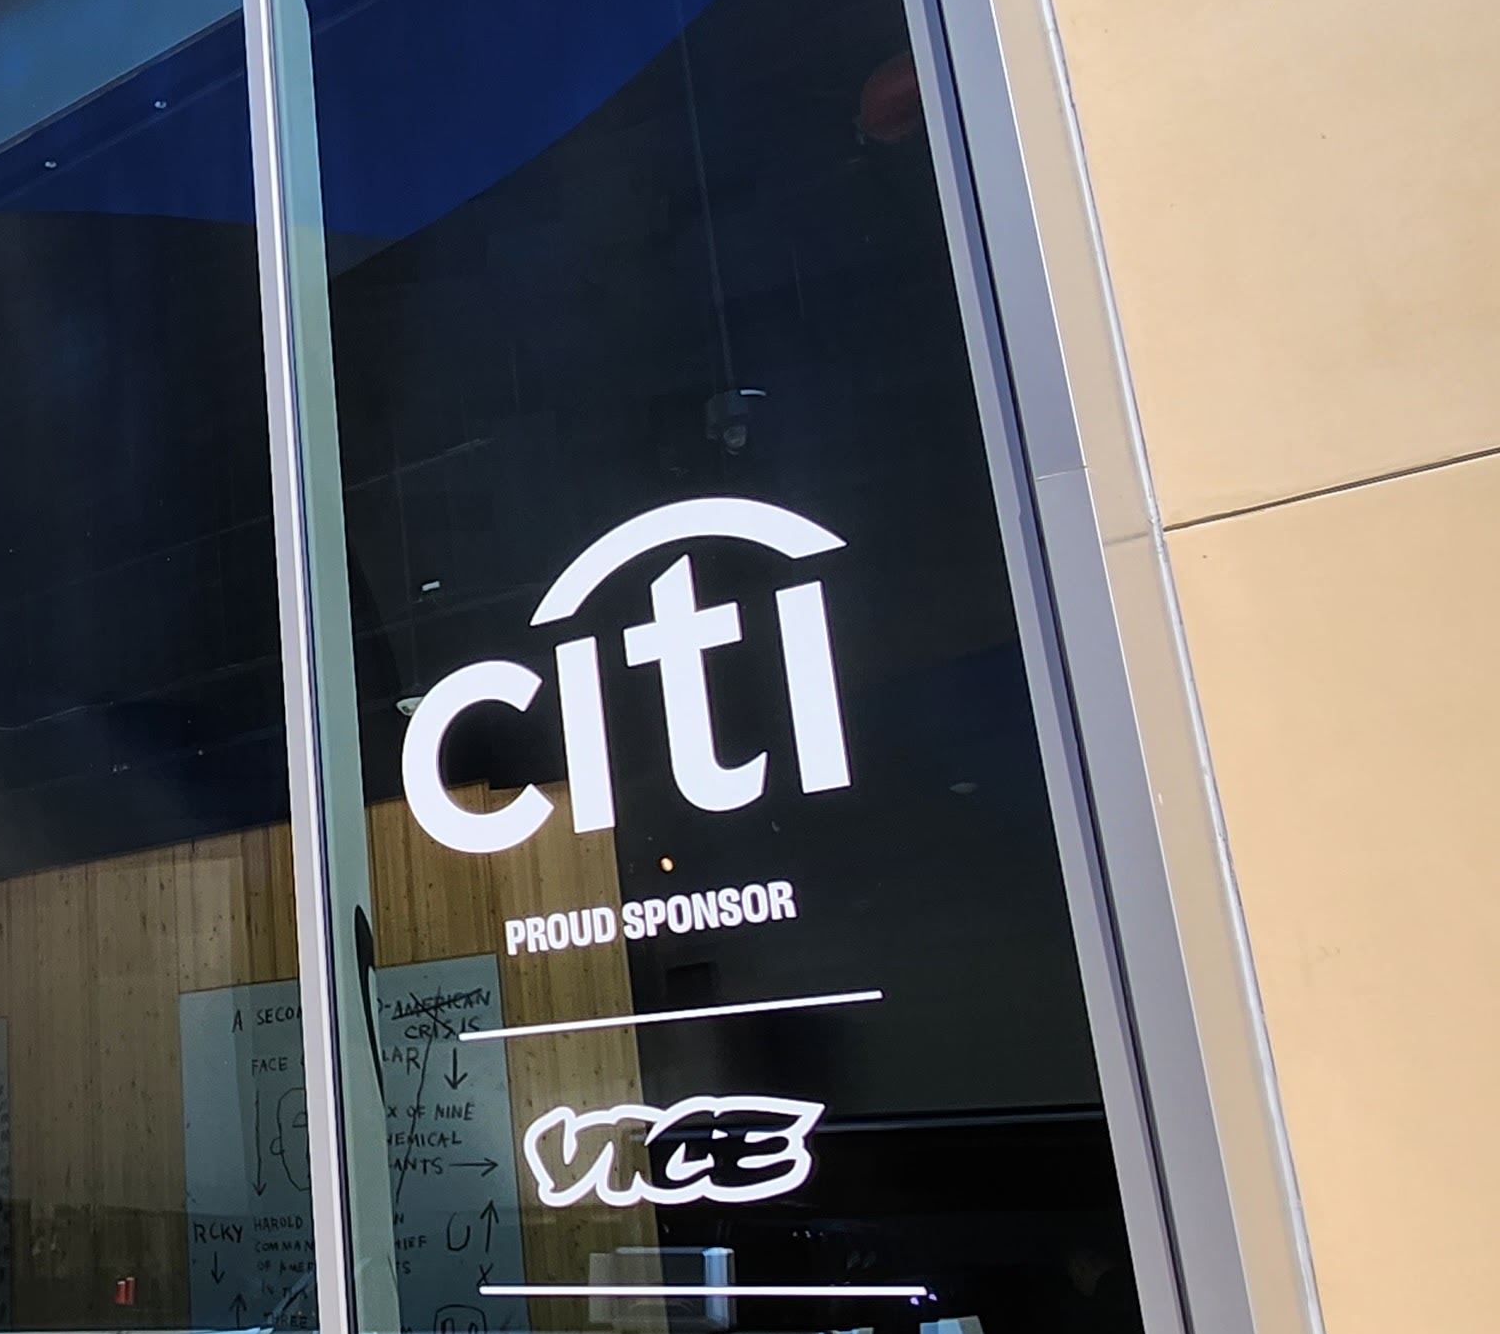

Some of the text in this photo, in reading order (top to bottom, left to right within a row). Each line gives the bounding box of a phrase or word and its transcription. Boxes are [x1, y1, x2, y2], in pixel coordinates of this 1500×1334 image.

[402, 497, 852, 854] citi
[505, 879, 798, 956] PROUD SPONSOR
[256, 1005, 302, 1026] SECO
[250, 1056, 289, 1076] FACE
[434, 1102, 475, 1121] NINE
[523, 1095, 826, 1208] VICE
[254, 1216, 304, 1232] HAROLD
[255, 1240, 315, 1253] COMMAN
